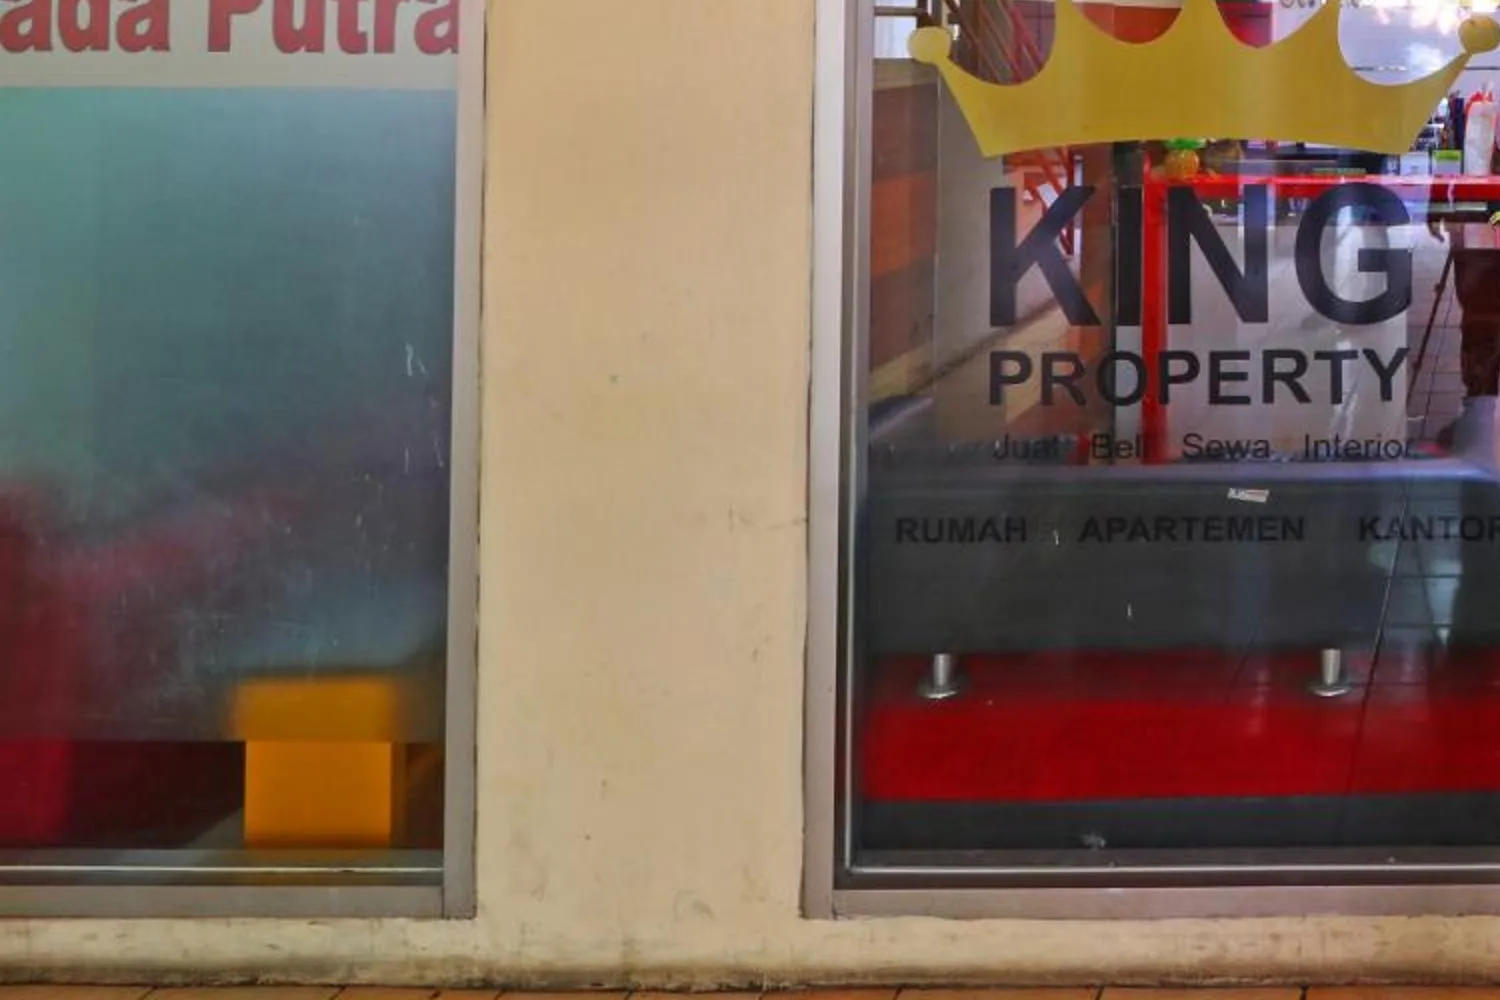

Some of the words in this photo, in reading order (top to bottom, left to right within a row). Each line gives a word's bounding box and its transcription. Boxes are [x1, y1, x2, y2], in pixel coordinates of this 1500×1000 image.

[989, 180, 1413, 328] KING
[988, 346, 1411, 408] PROPERTY
[1182, 433, 1271, 461] Sewa
[1303, 433, 1411, 460] Interior
[895, 516, 1028, 543] RUMAH
[1077, 515, 1305, 543] APARTEMEN
